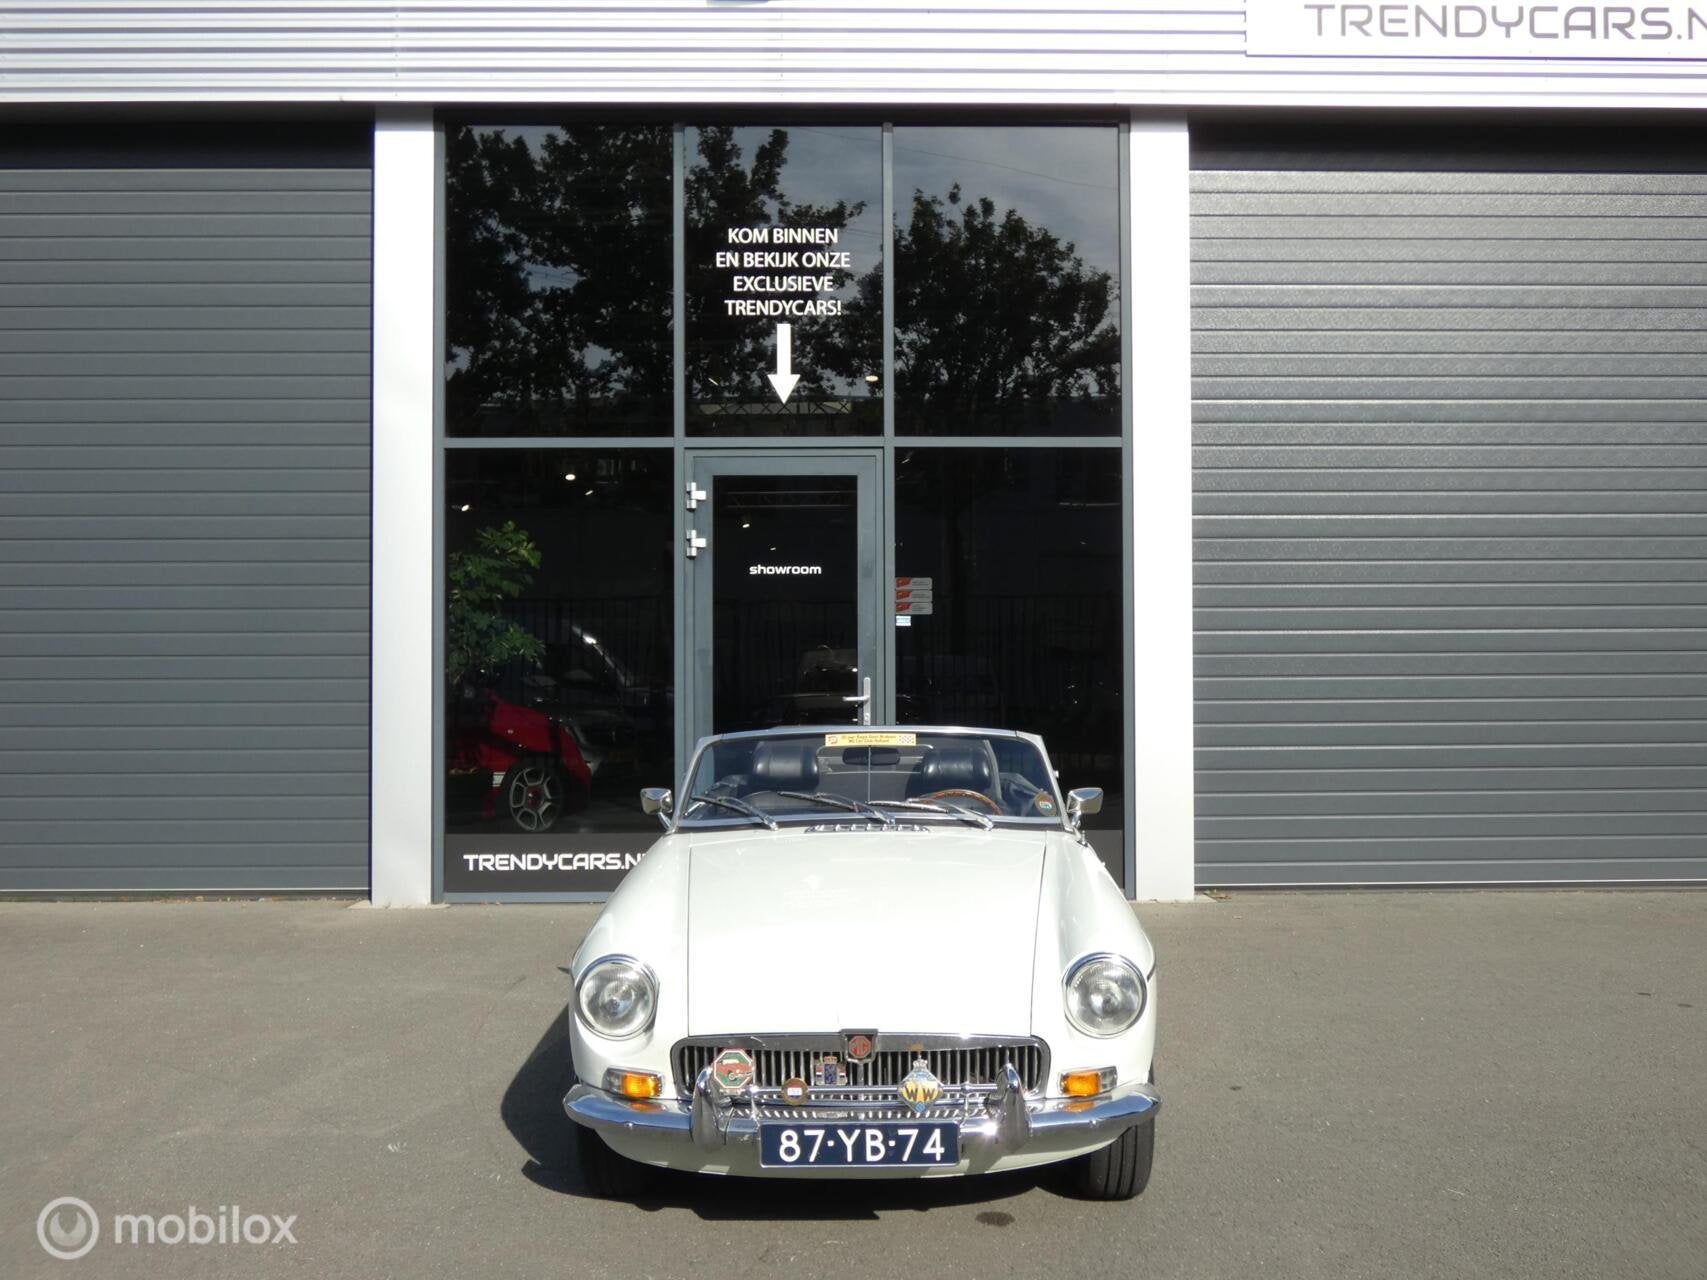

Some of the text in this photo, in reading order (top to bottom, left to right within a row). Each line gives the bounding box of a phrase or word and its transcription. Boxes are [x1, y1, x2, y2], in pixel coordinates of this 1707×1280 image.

[728, 227, 839, 244] KOM BINNEN
[716, 251, 851, 268] EN BEKIJK ONZE
[733, 275, 834, 292] EXCLUSIEVE
[725, 299, 842, 316] TRENDYCARS!
[749, 564, 822, 575] showroom
[463, 853, 647, 871] TRENDYCARS.N
